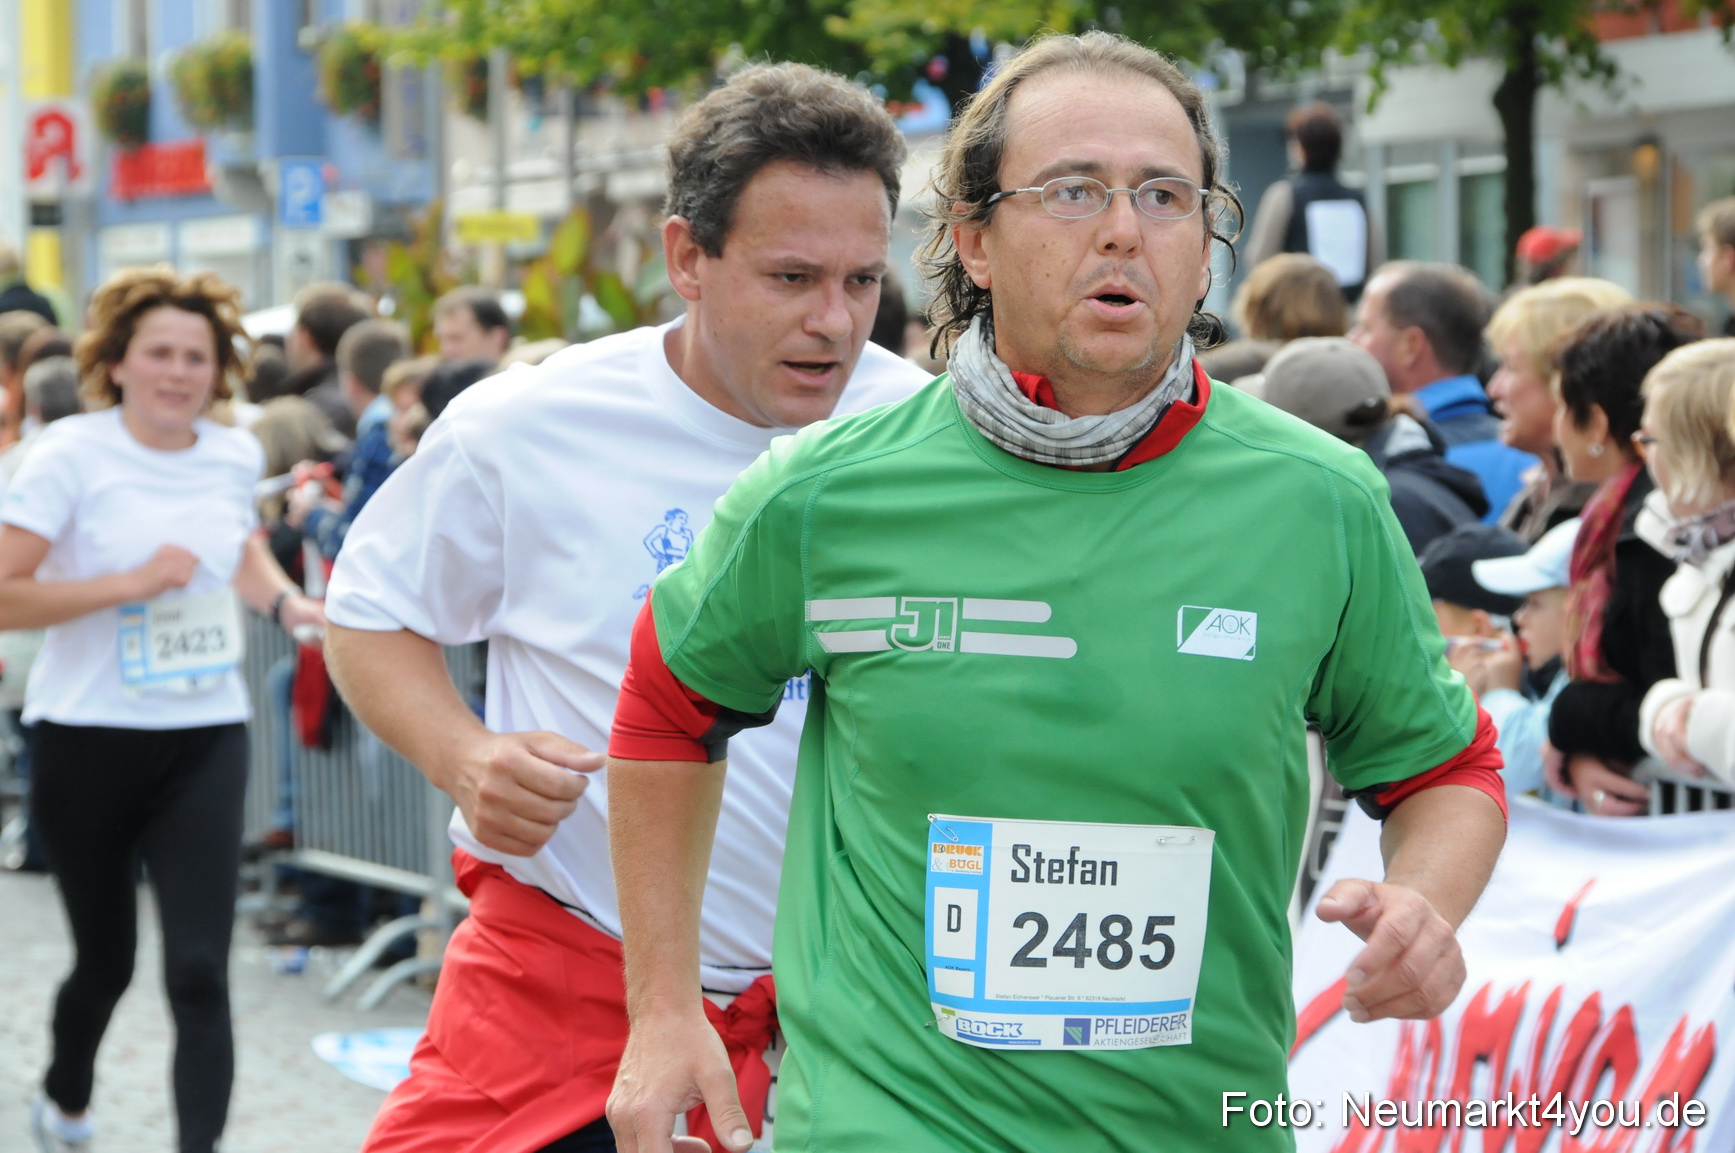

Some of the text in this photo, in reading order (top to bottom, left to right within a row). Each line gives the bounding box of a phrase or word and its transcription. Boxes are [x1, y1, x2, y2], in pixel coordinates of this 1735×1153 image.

[1205, 614, 1251, 636] AOK
[154, 624, 226, 661] 2423
[937, 641, 951, 650] ONE
[933, 843, 982, 857] DRUCK
[932, 857, 982, 872] & BÖGL
[1010, 843, 1118, 886] Stefan
[947, 904, 962, 933] D
[1009, 911, 1176, 971] 2485
[956, 1017, 1023, 1038] BOCK
[1095, 1013, 1187, 1035] PFLEIDERER
